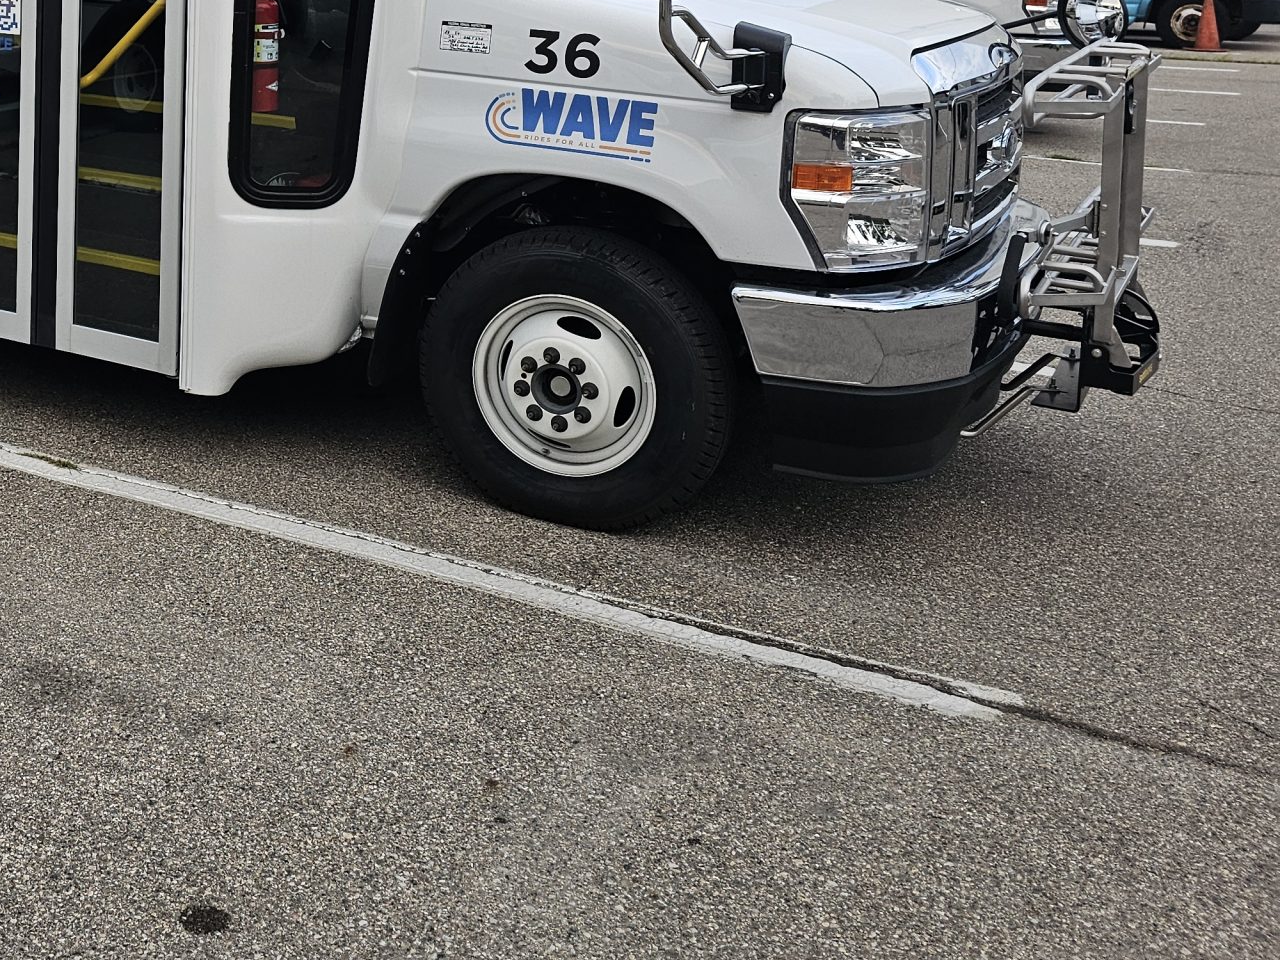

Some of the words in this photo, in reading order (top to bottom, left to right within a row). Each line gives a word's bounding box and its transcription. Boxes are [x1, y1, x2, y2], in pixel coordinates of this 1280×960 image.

[524, 28, 601, 79] 36
[521, 88, 658, 147] WAVE
[524, 134, 551, 143] RIDES
[556, 138, 573, 146] FOR
[578, 141, 595, 149] ALL
